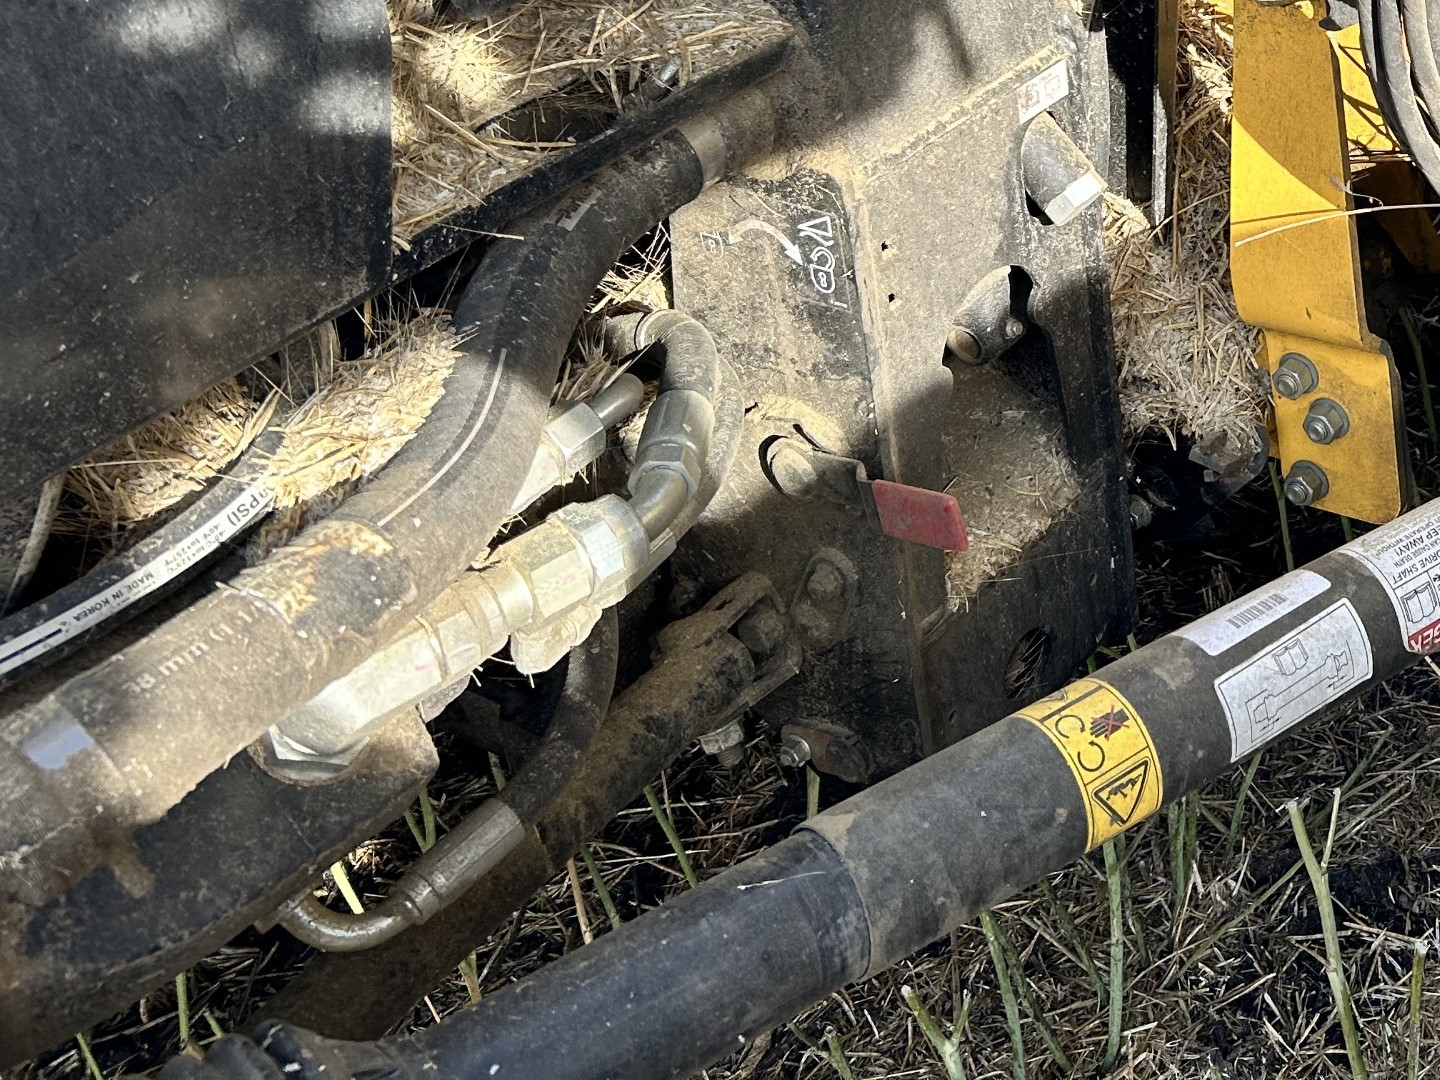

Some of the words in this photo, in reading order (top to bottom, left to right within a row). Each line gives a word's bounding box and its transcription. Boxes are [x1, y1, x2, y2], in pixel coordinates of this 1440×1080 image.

[226, 493, 260, 527] PSI)
[1395, 536, 1425, 557] AWAY!
[1410, 545, 1430, 559] CAUSE
[1428, 539, 1440, 550] CAN
[1394, 554, 1412, 568] DEATH
[127, 571, 155, 592] MADE
[1392, 561, 1419, 585] SHAFT
[112, 589, 126, 601] IN
[73, 598, 110, 622] KOREA
